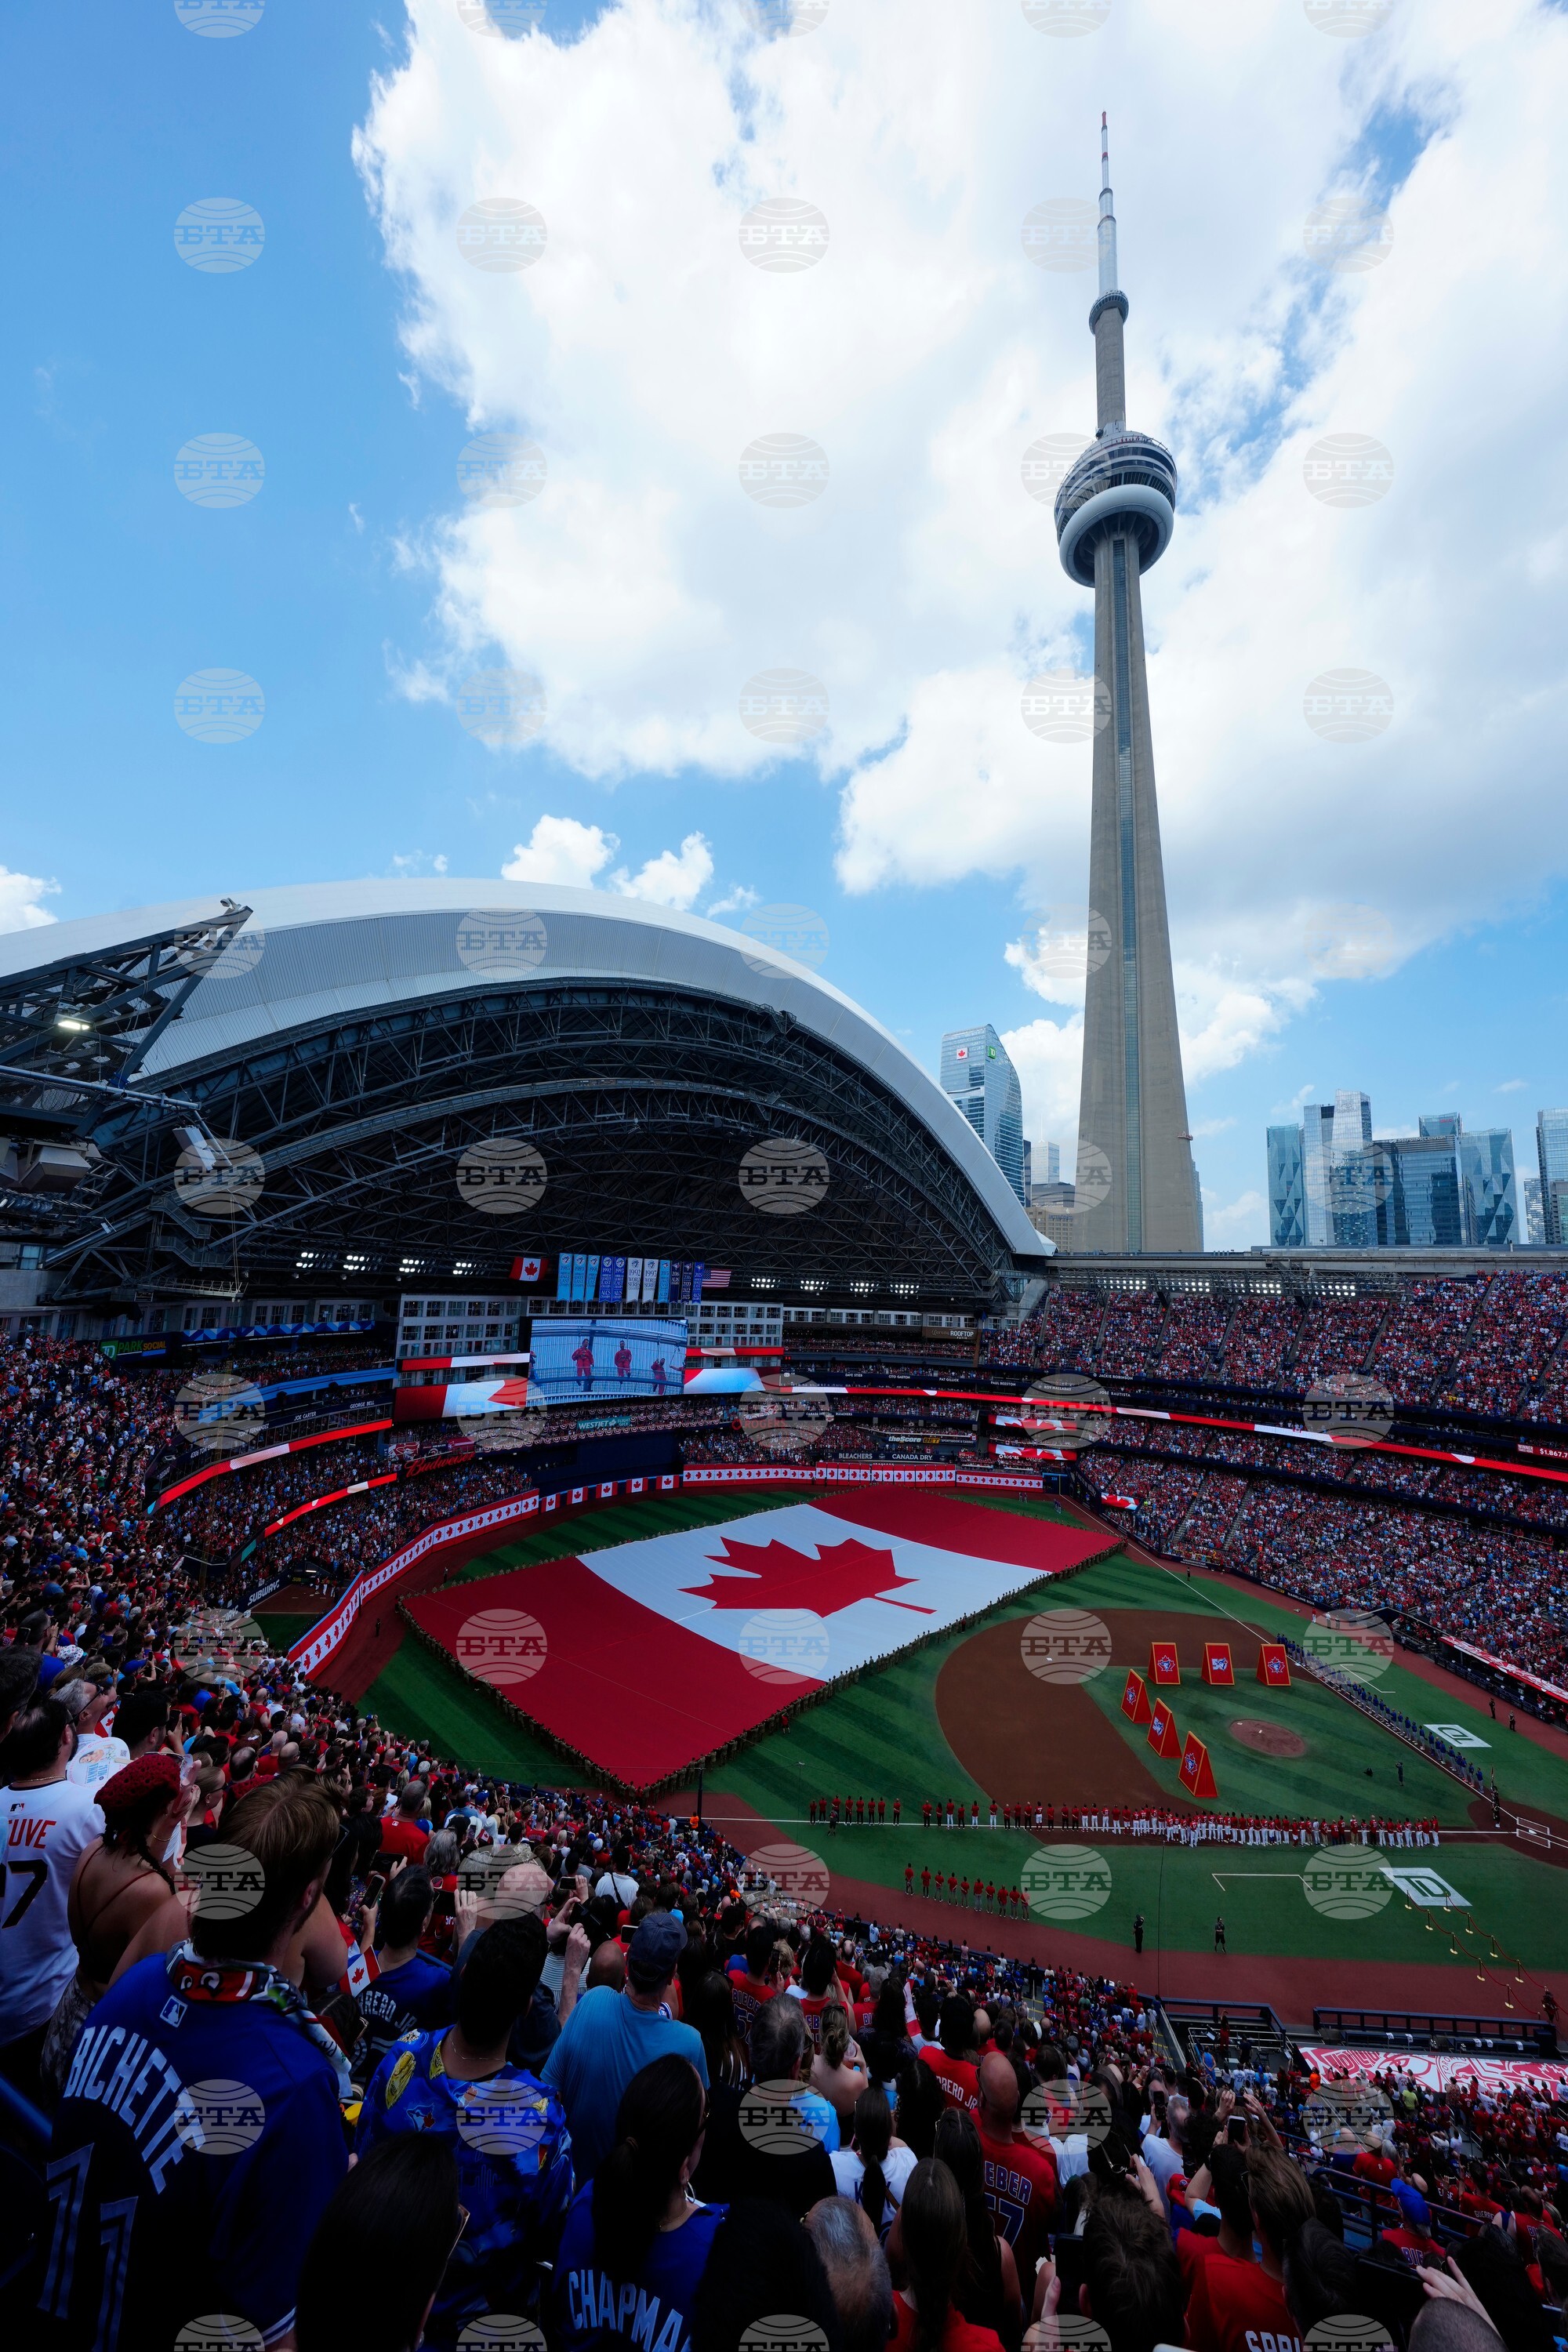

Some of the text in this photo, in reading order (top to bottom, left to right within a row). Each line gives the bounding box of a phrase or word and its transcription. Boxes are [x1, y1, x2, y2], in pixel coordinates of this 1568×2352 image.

[118, 1340, 144, 1353] PARK
[142, 1341, 167, 1352] SOCIAL
[579, 1420, 609, 1430] WESTJET
[745, 1418, 786, 1429] ROGERS
[888, 1435, 922, 1443] theScore
[405, 1451, 475, 1478] Budweiser
[248, 1579, 280, 1606] SUBWAY
[1393, 1875, 1451, 1897] TD
[63, 2024, 206, 2195] BICHETTE
[568, 2270, 695, 2352] CHAPMA
